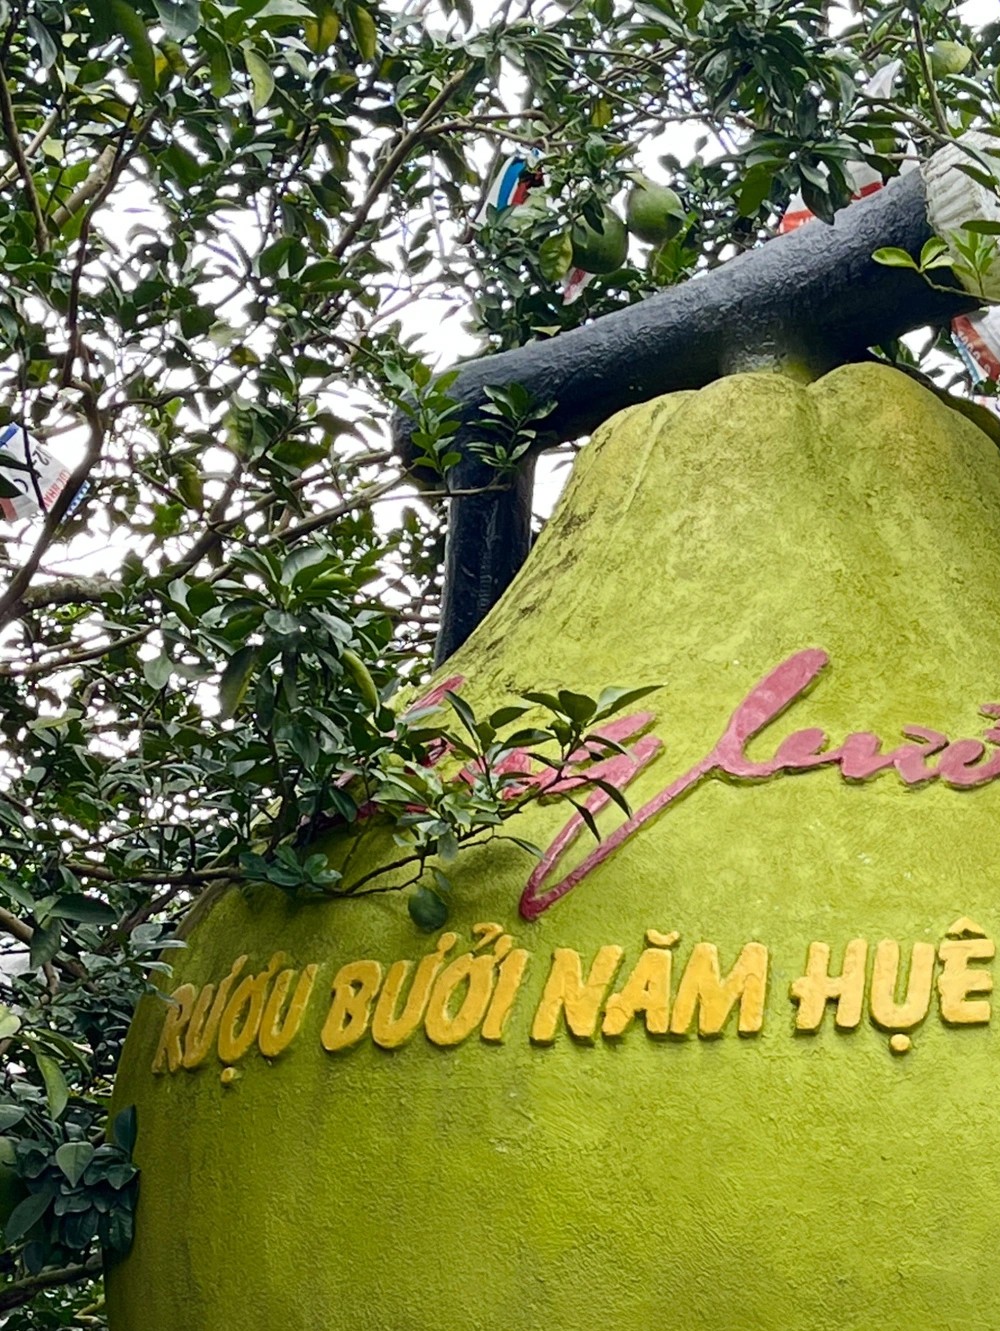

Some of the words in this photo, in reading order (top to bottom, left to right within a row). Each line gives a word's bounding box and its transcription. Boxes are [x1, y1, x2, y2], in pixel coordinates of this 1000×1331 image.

[151, 951, 318, 1084] RƯỢU
[321, 922, 529, 1052] BƯỞI
[529, 928, 769, 1043] NĂM
